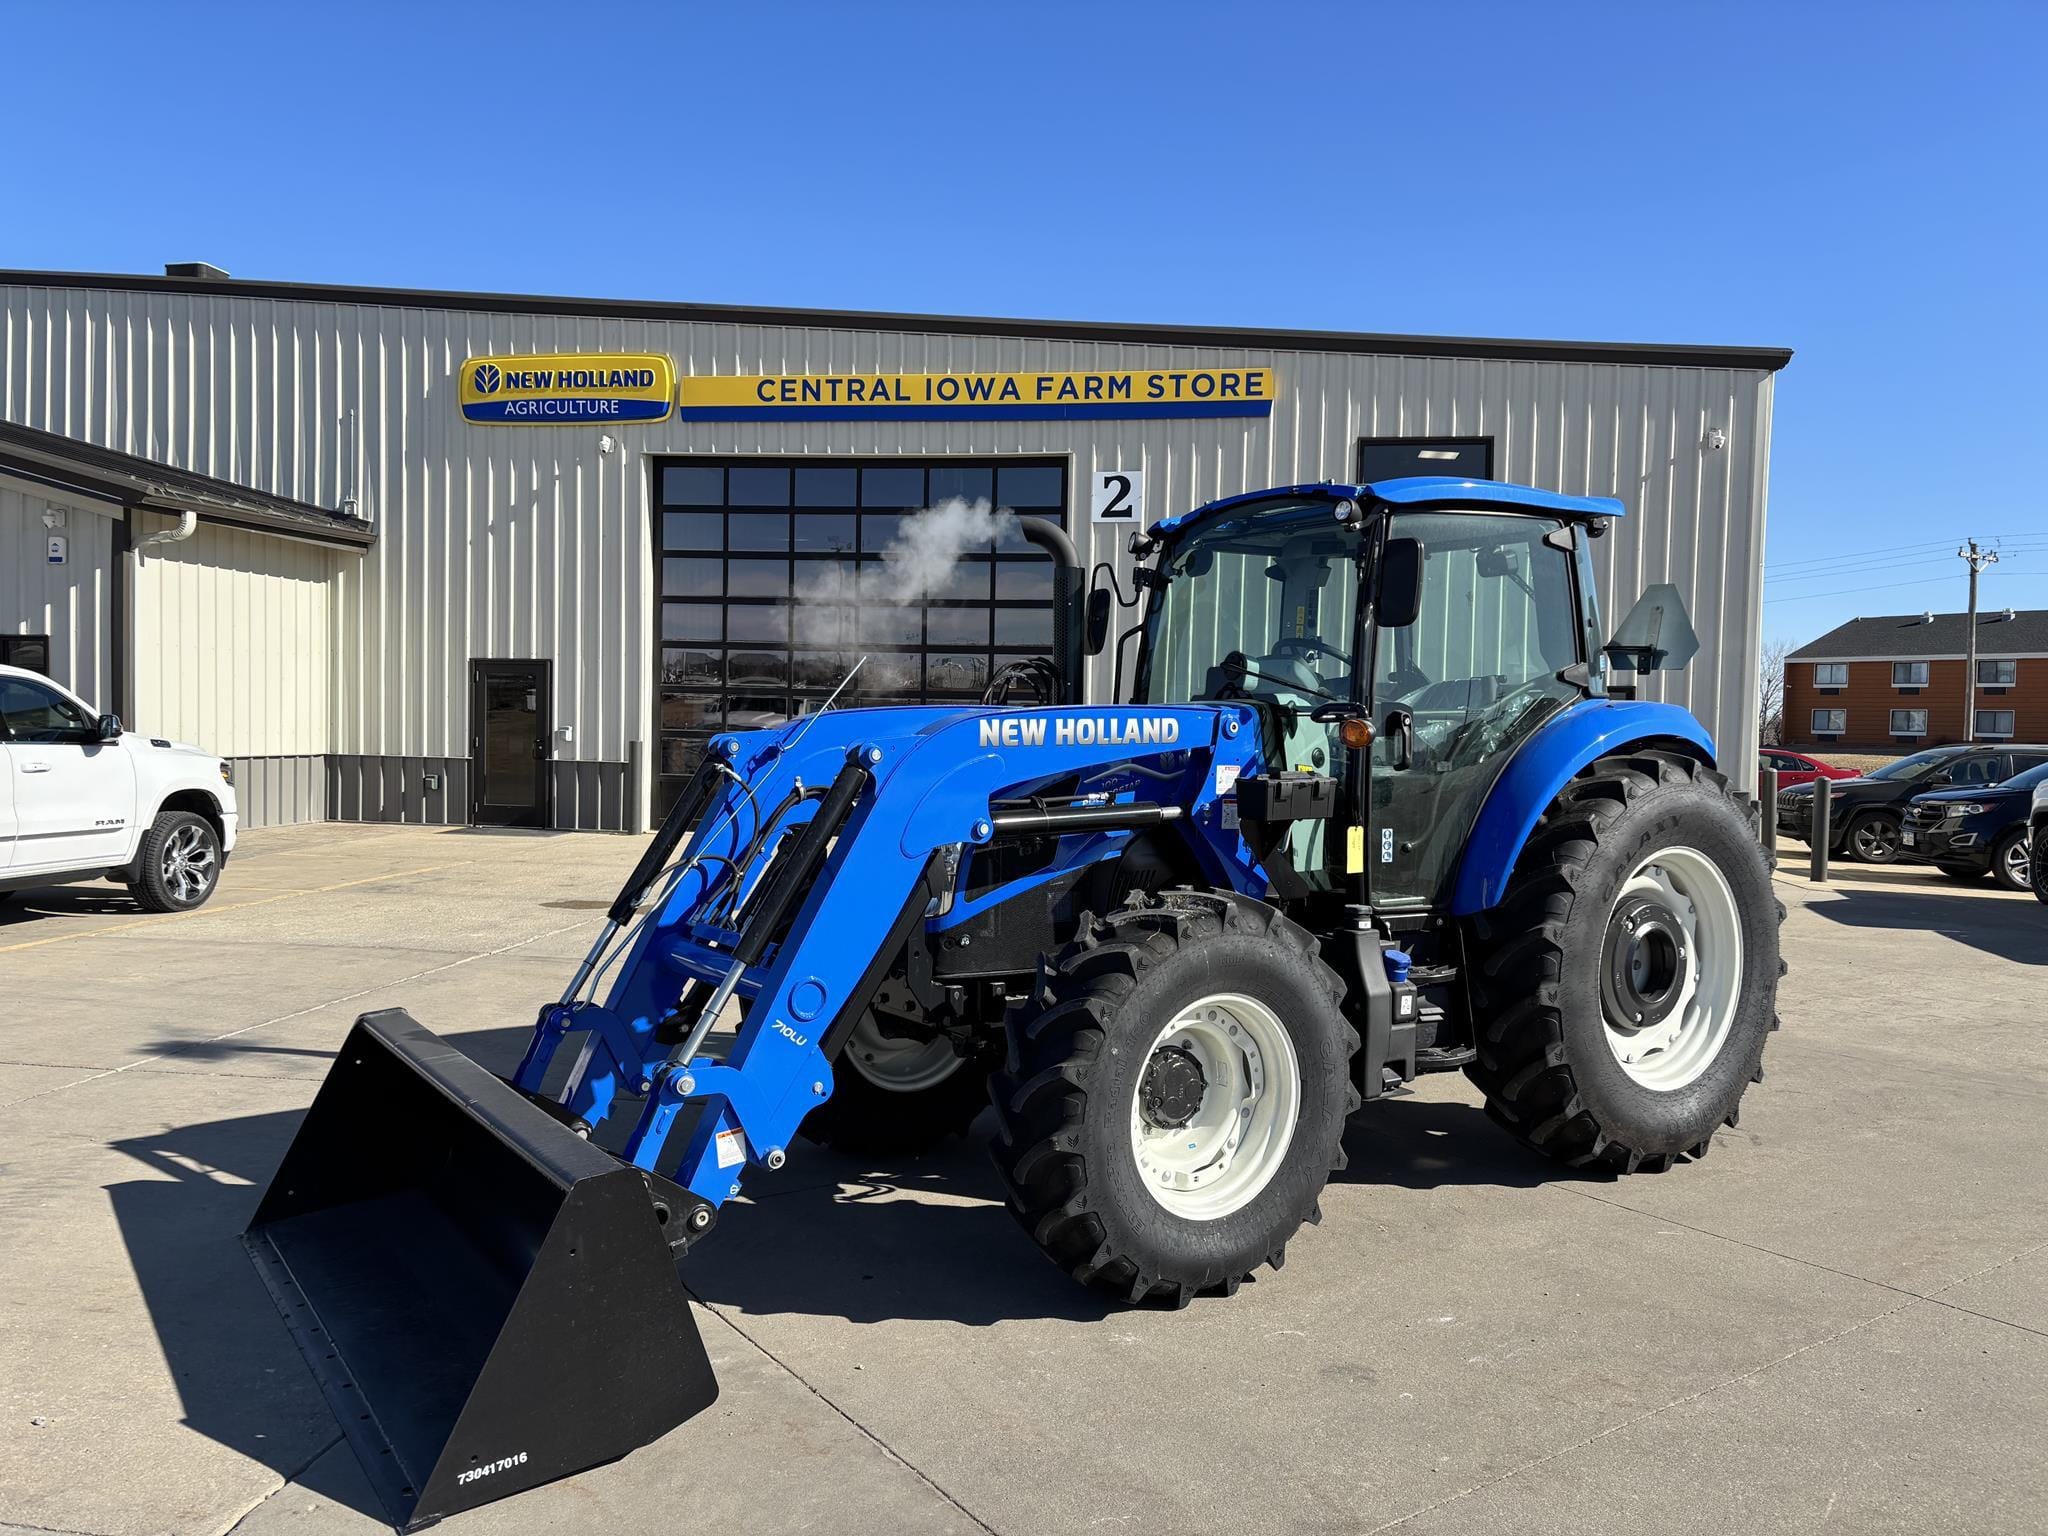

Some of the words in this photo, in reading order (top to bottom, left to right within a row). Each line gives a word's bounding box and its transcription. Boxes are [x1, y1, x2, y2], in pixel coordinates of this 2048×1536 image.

[506, 370, 554, 389] NEW
[558, 368, 655, 389] HOLLAND
[757, 377, 911, 402] CENTRAL
[926, 376, 1021, 402] IOWA
[1036, 374, 1131, 400] FARM
[1147, 372, 1264, 398] STORE
[504, 399, 619, 415] AGRICULTURE
[1101, 474, 1133, 519] 2
[979, 718, 1048, 747] NEW
[1055, 717, 1179, 746] HOLLAND
[771, 1019, 808, 1046] 710LU
[457, 1451, 528, 1486] 730417016
